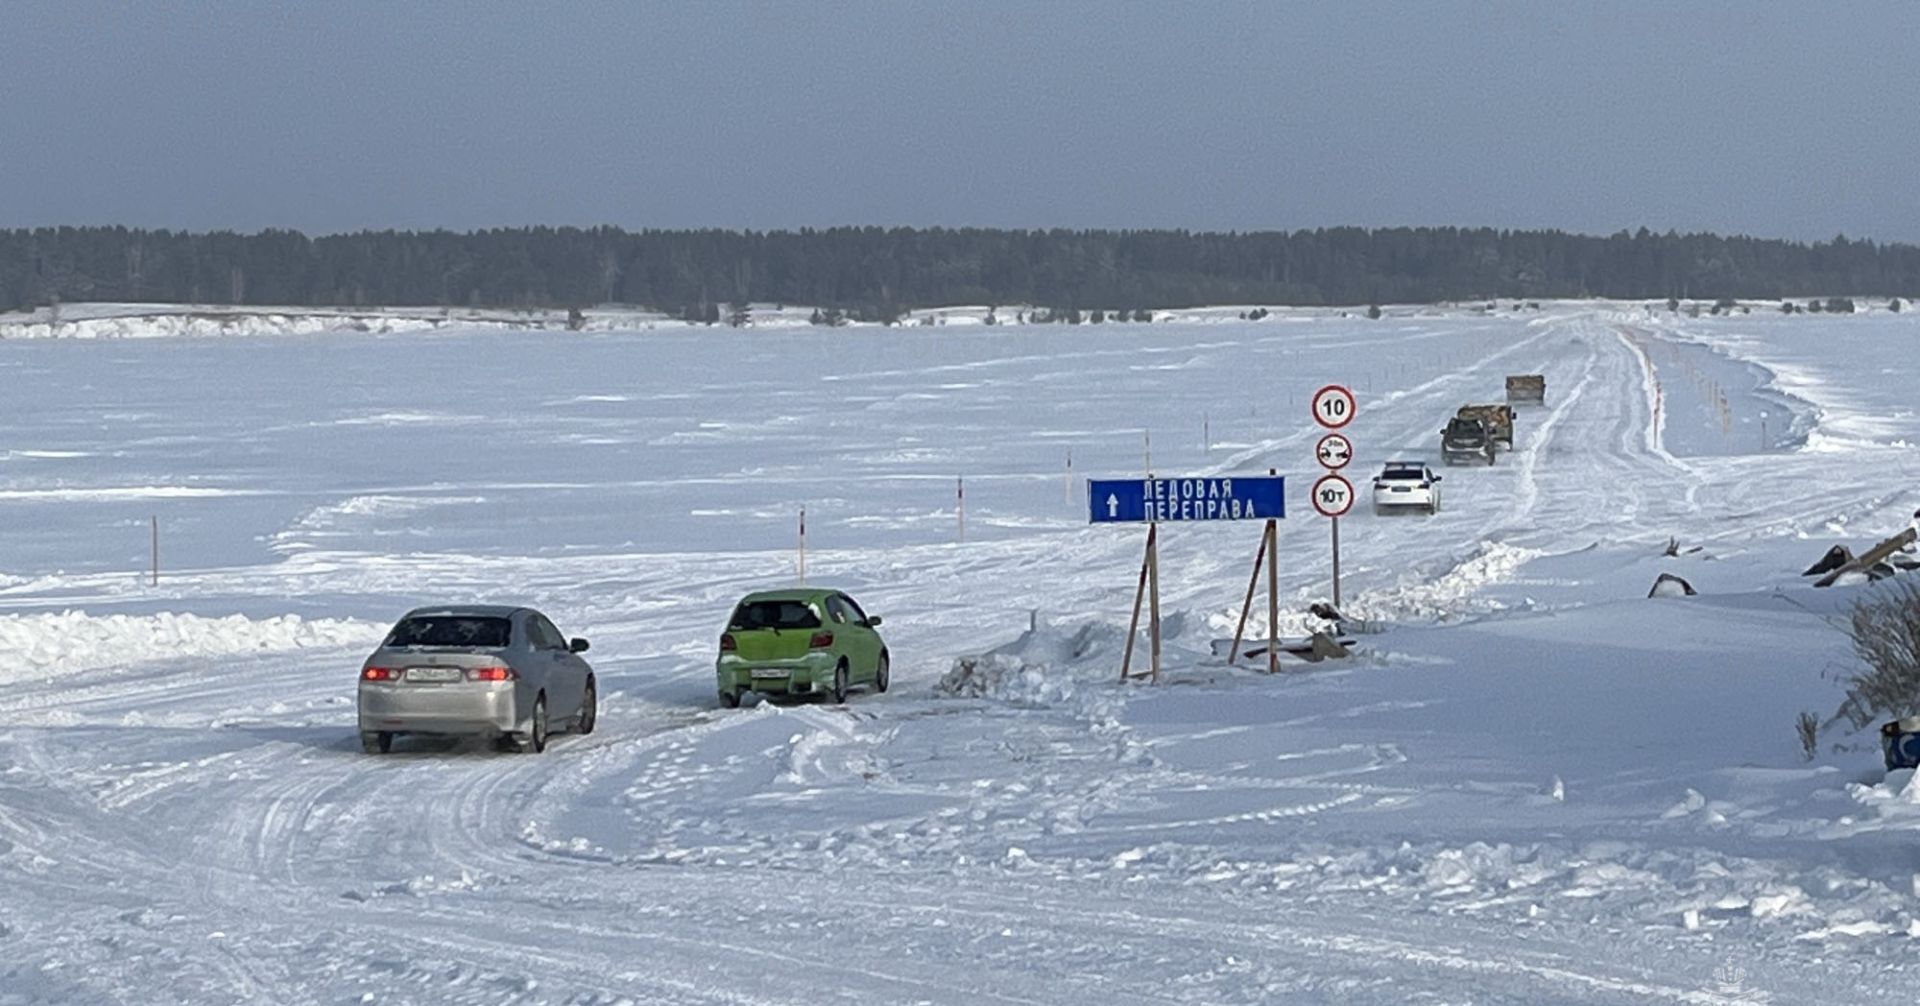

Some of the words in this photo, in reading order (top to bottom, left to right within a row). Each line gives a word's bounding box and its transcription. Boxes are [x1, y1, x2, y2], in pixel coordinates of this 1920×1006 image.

[1323, 399, 1345, 416] 10
[1143, 479, 1233, 500] ЛЕДОВАЯ
[1144, 499, 1256, 522] ПЕРЕПРАВА
